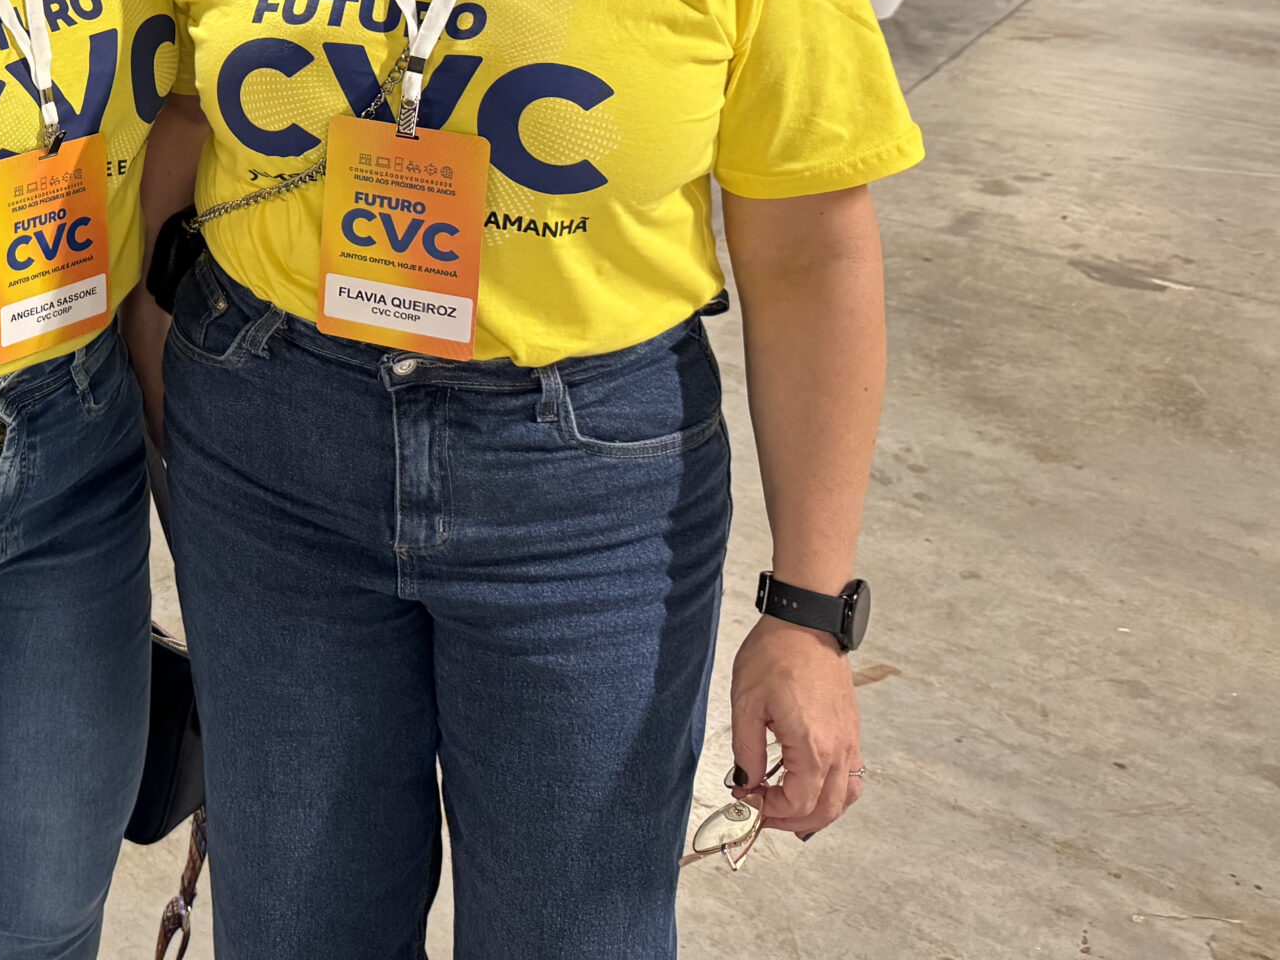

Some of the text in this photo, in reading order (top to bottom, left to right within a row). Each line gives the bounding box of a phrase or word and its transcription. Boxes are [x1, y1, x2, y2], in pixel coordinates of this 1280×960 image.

[216, 37, 615, 196] CVC
[353, 174, 375, 184] RUMO
[375, 177, 390, 186] AOS
[391, 179, 426, 193] PRÓXIMOS
[436, 187, 457, 197] ANOS
[354, 191, 427, 215] FUTURO
[14, 208, 68, 234] FUTURO
[483, 211, 590, 238] AMANHÃ
[6, 216, 94, 271] CVC
[341, 208, 460, 262] CVC
[338, 250, 368, 262] JUNTOS
[368, 256, 397, 269] ONTEM,
[397, 260, 418, 272] HOJE
[423, 266, 458, 279] AMANHÃ
[7, 276, 31, 289] JUNTOS
[10, 286, 98, 323] ANGELICA SASSONE
[36, 305, 73, 323] CVC CORP
[338, 286, 458, 319] FLAVIA QUEIROZ
[371, 306, 421, 322] CVC CORP
